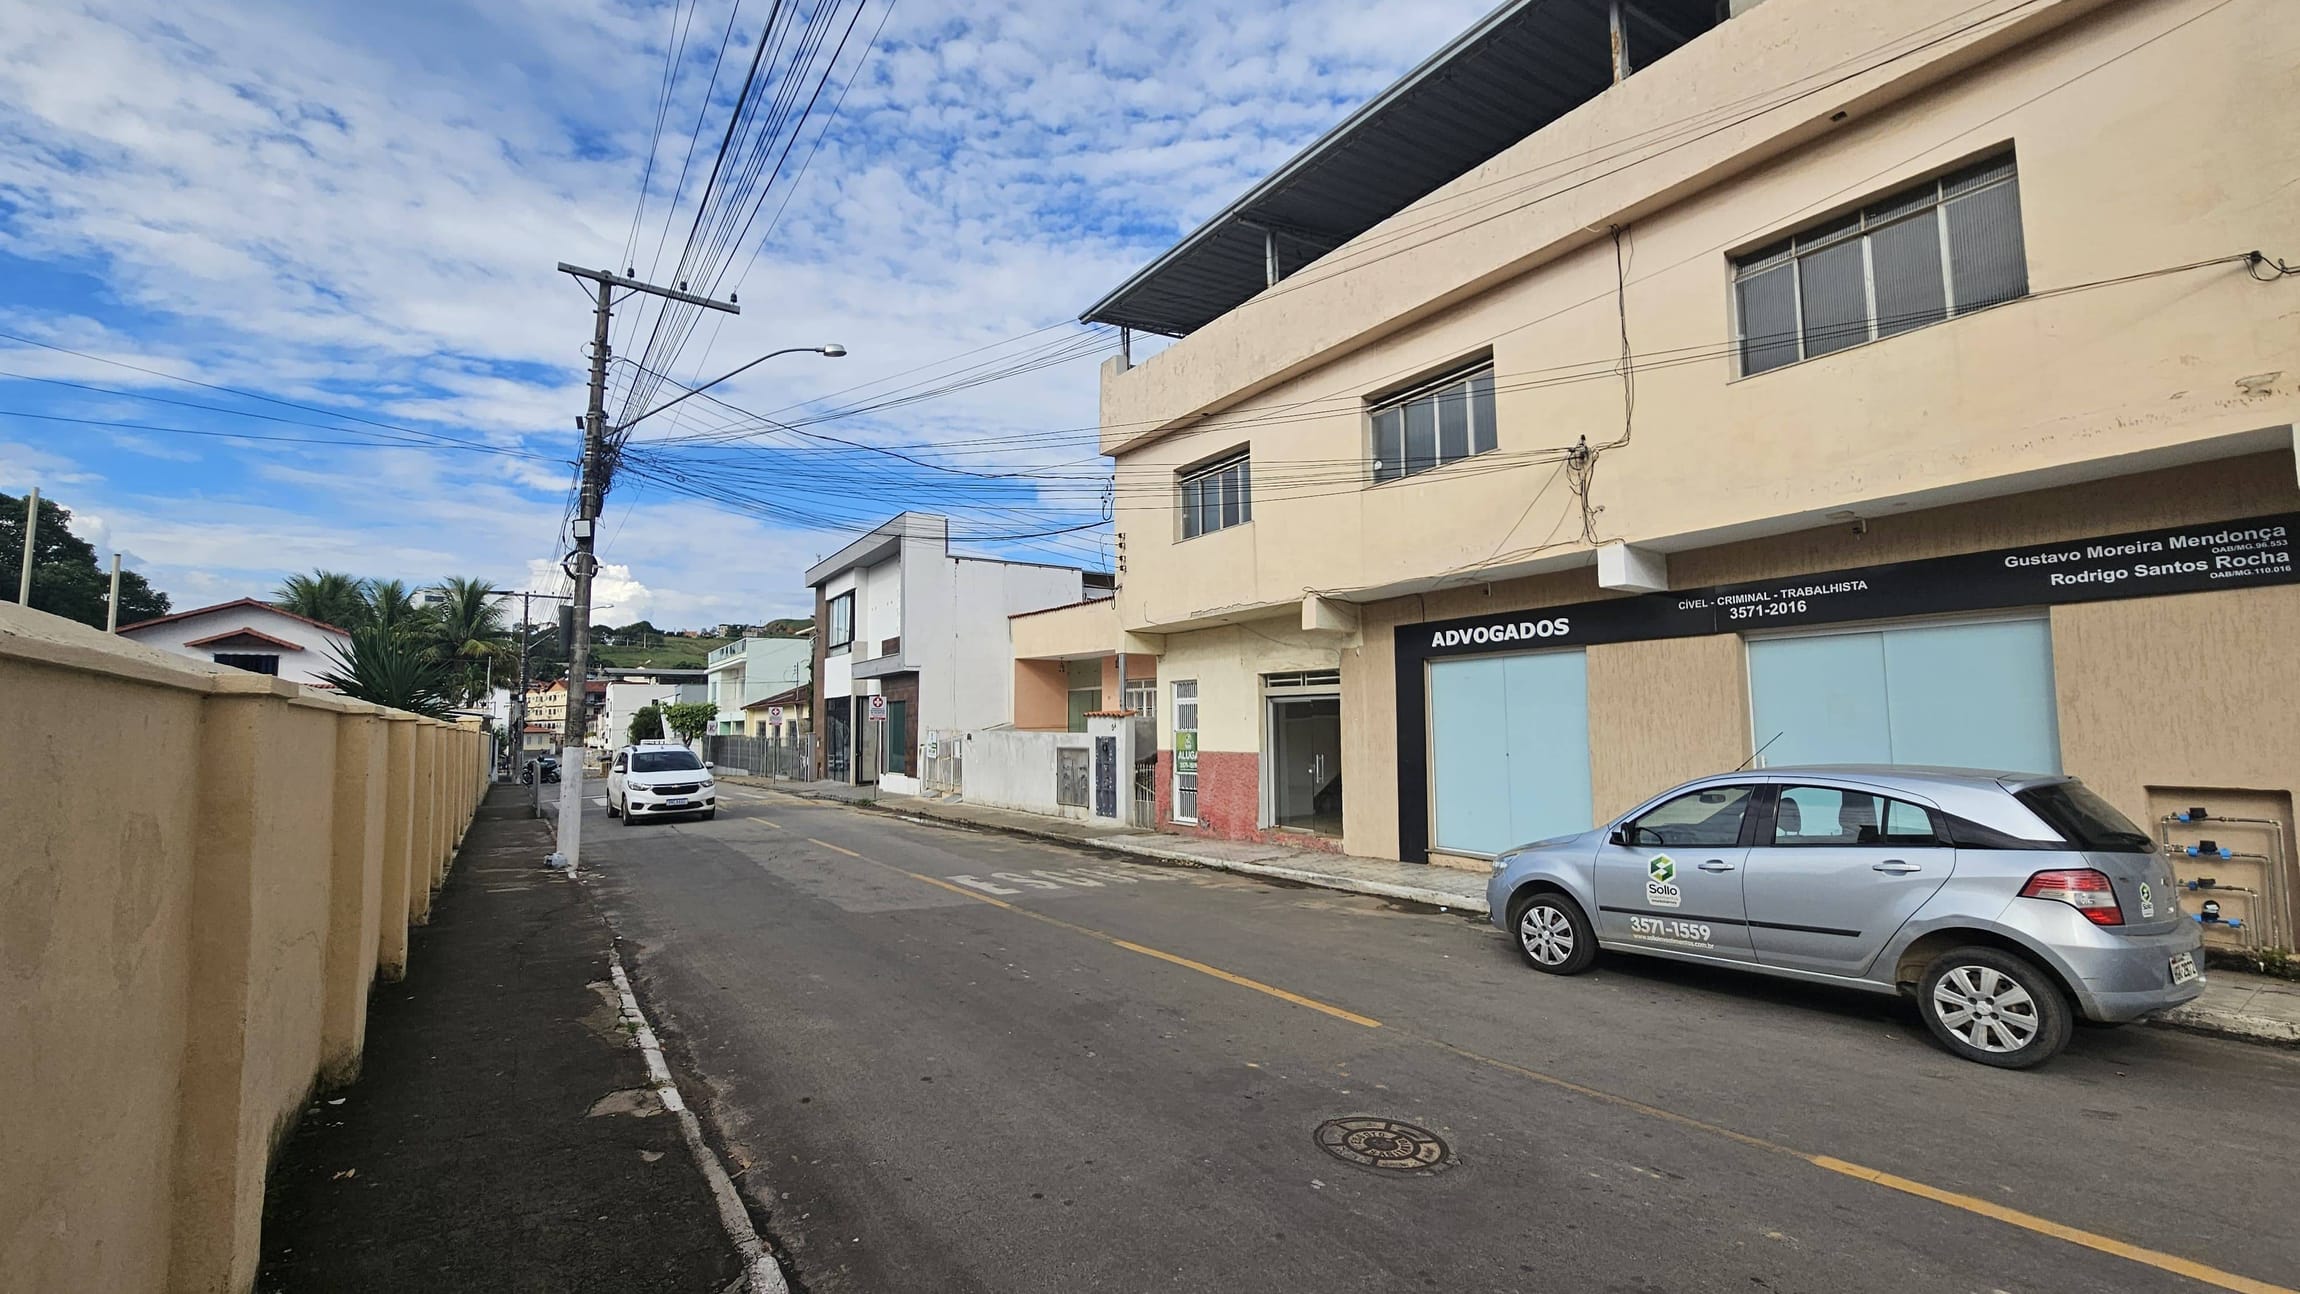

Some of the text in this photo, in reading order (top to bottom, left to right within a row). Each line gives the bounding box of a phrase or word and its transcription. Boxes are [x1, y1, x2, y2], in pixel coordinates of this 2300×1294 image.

[2004, 525, 2287, 568] Gustavo Moreira Mendonça
[2211, 538, 2289, 554] OAB/MG.96.553
[2050, 551, 2290, 586] Rodrigo Santos Rocha
[2209, 565, 2292, 579] OAB/MG.110.016
[1678, 598, 1708, 610] CÍVEL
[1716, 591, 1771, 606] CRIMINAL
[1780, 580, 1868, 599] TRABALHISTA
[1729, 600, 1807, 620] 3571-2016
[1431, 617, 1570, 648] ADVOGADOS
[1648, 883, 1678, 896] Sollo
[1630, 916, 1711, 941] 3571-1559
